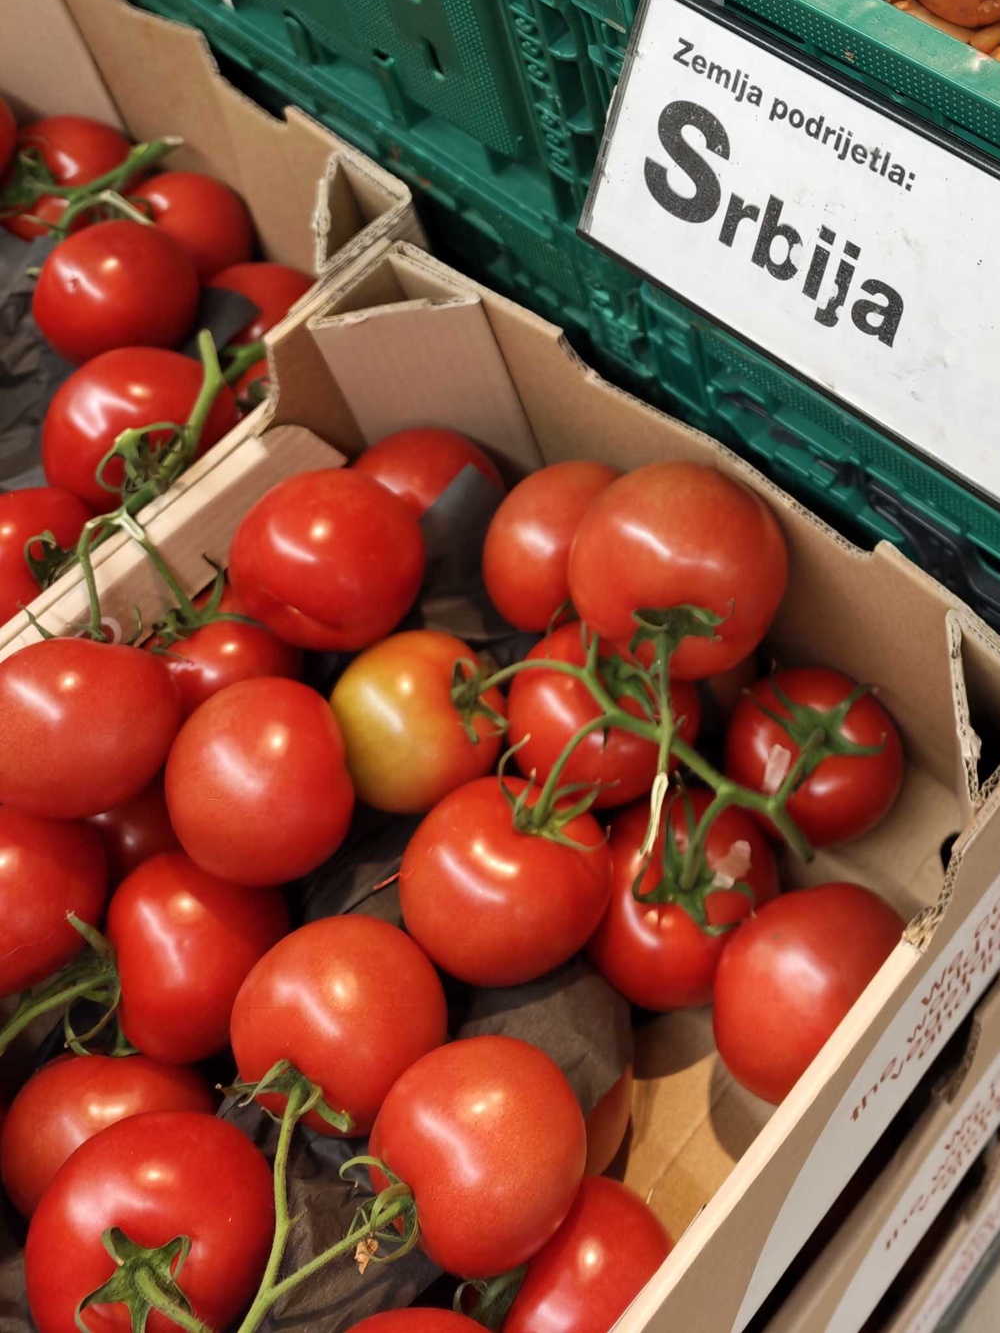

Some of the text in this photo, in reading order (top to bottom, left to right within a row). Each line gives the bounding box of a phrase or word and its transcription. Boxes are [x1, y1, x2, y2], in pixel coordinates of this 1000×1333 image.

[673, 37, 916, 191] Zemlja podrijetla:
[644, 100, 904, 348] Srbija
